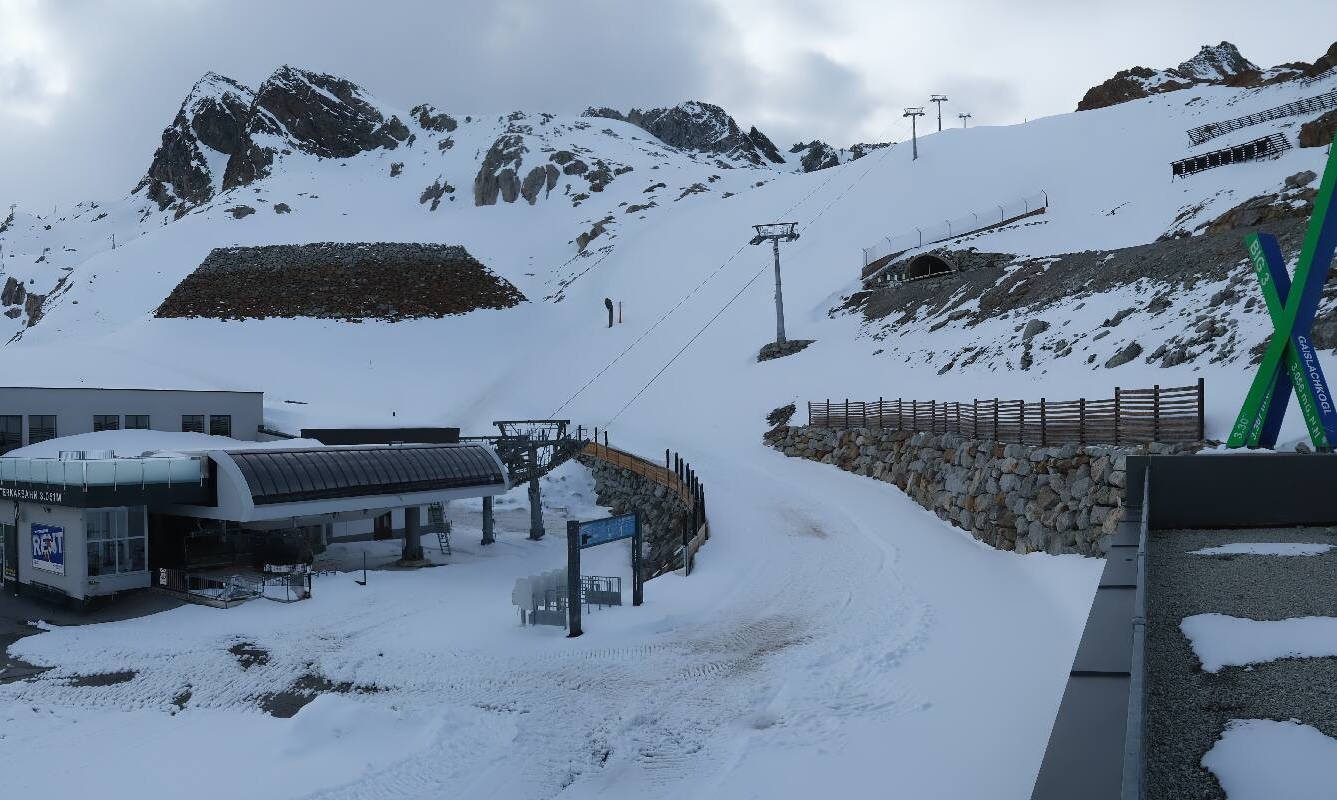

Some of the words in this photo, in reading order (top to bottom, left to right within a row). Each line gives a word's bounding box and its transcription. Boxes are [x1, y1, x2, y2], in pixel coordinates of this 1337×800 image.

[1250, 239, 1265, 272] BIG
[1261, 273, 1270, 287] 3
[1298, 336, 1331, 415] GAISLACHKOGL
